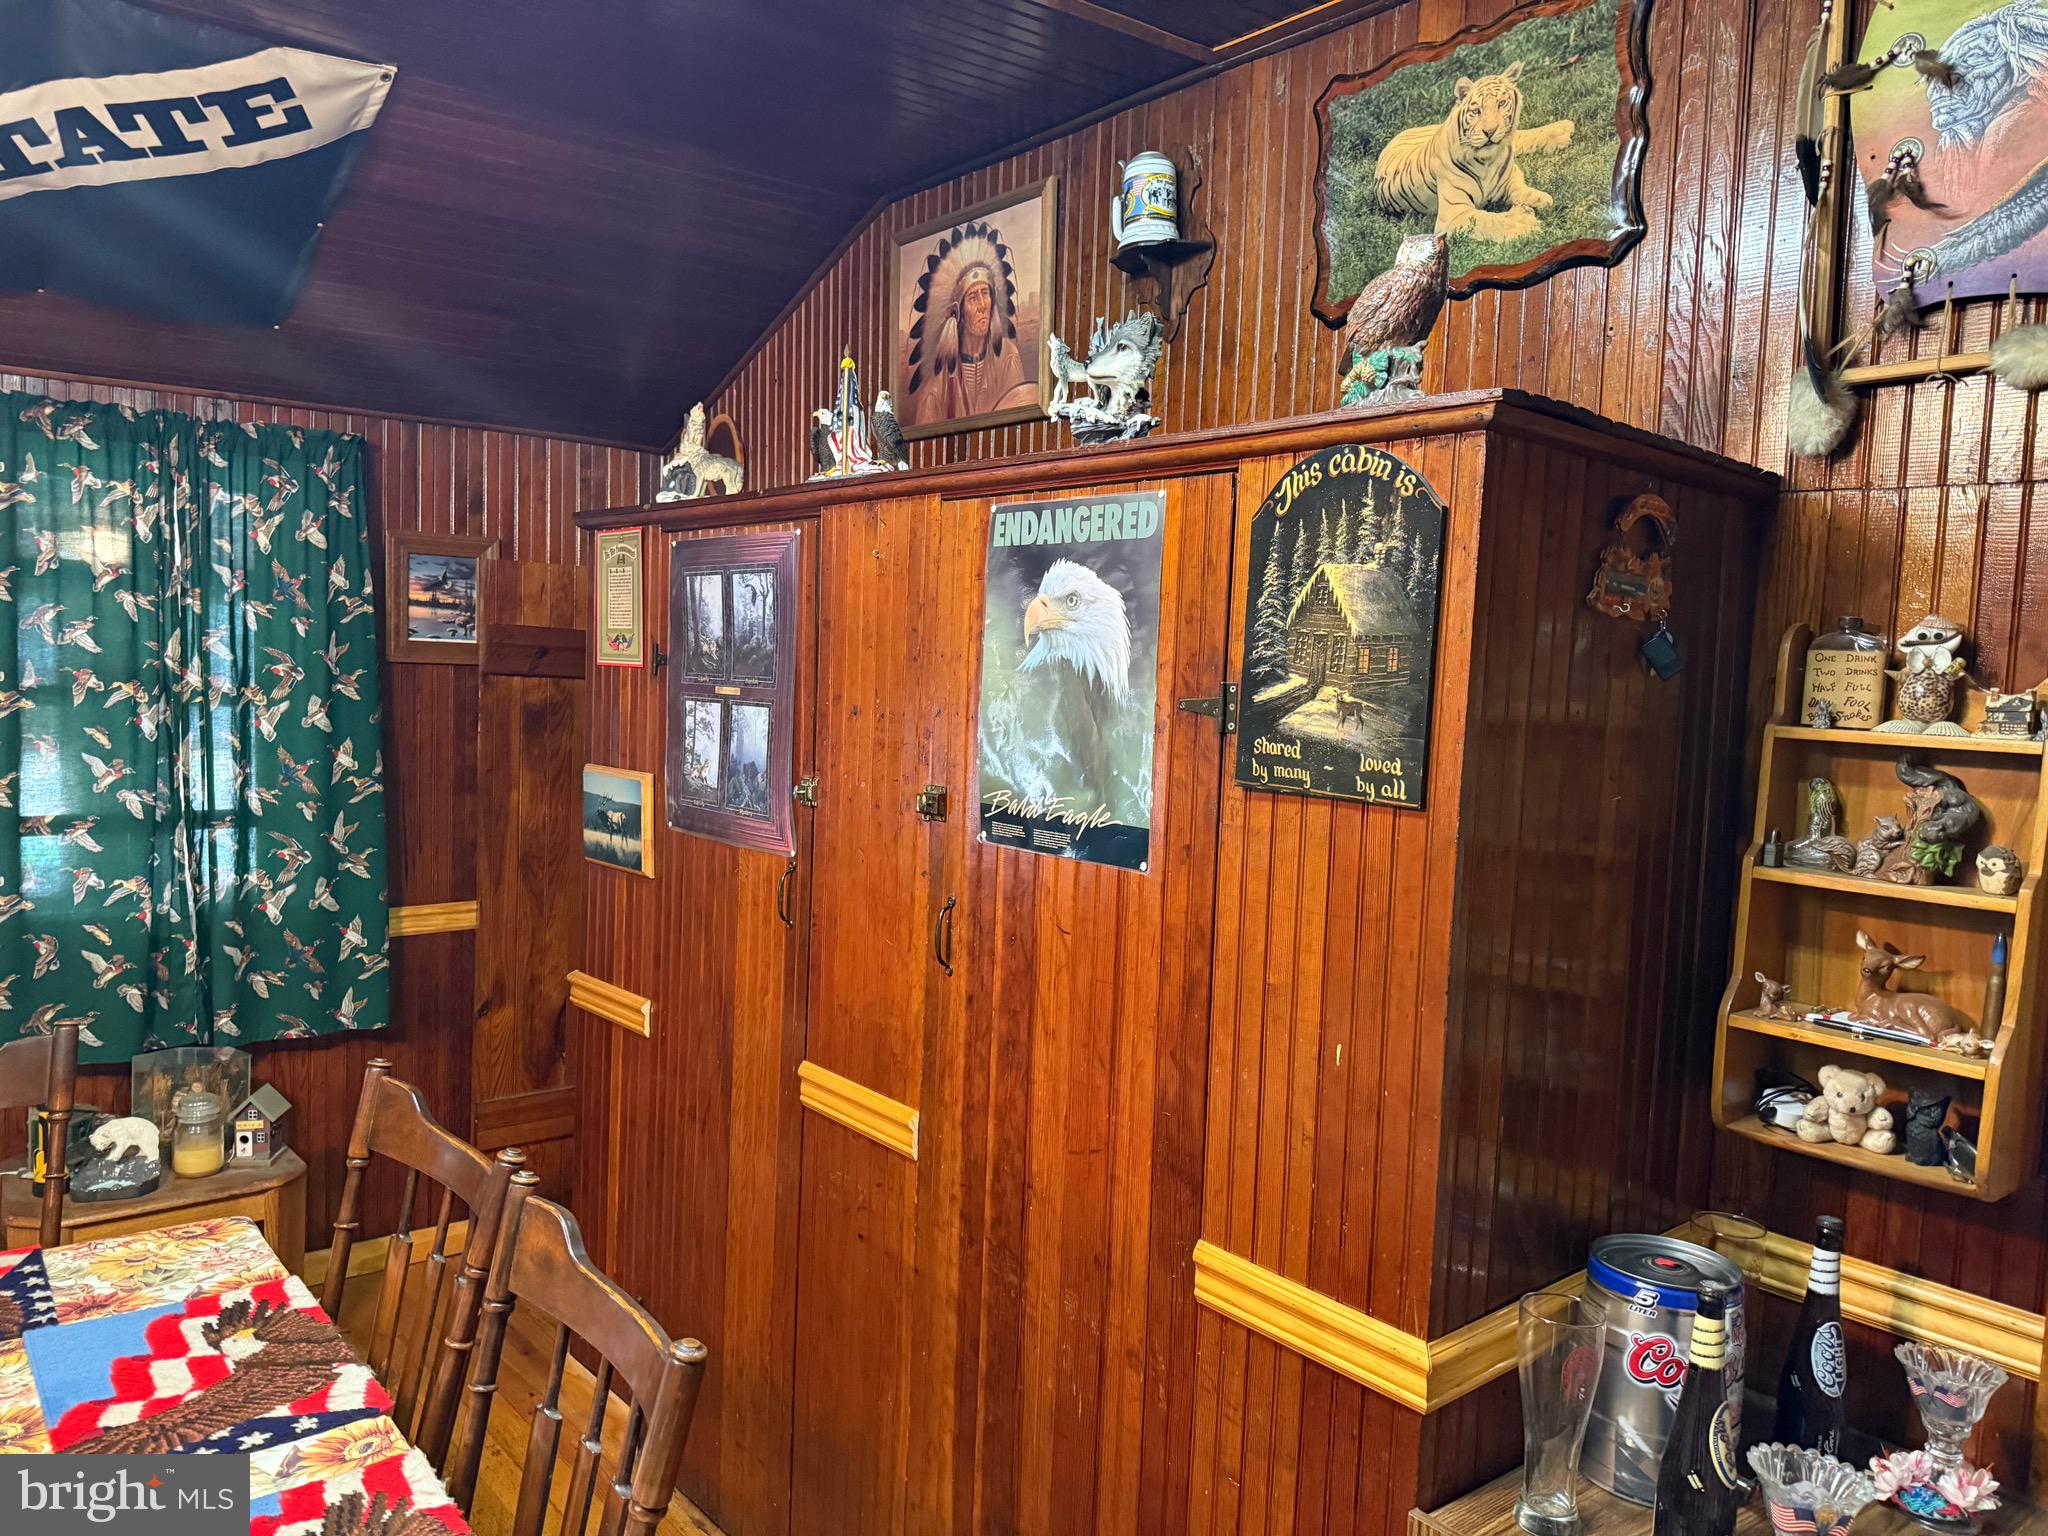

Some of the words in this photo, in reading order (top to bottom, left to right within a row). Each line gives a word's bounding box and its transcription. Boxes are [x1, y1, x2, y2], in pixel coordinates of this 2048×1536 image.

[1275, 462, 1323, 517] This
[1328, 446, 1393, 481] cabin
[1393, 465, 1417, 497] is
[993, 501, 1159, 547] ENDANGERED
[1845, 682, 1872, 692] FULL
[1843, 696, 1872, 712] FOOL
[1253, 736, 1301, 759] shared
[1252, 758, 1268, 784] by
[1273, 764, 1311, 789] many
[1359, 753, 1403, 776] loved
[1356, 776, 1375, 802] by
[1381, 778, 1407, 800] all
[983, 790, 1047, 819] Bald
[1045, 797, 1123, 841] Eagle
[1629, 1304, 1657, 1318] LITER
[1633, 1290, 1660, 1309] 5
[1815, 1328, 1836, 1388] Coors
[1834, 1338, 1845, 1382] LIGHT
